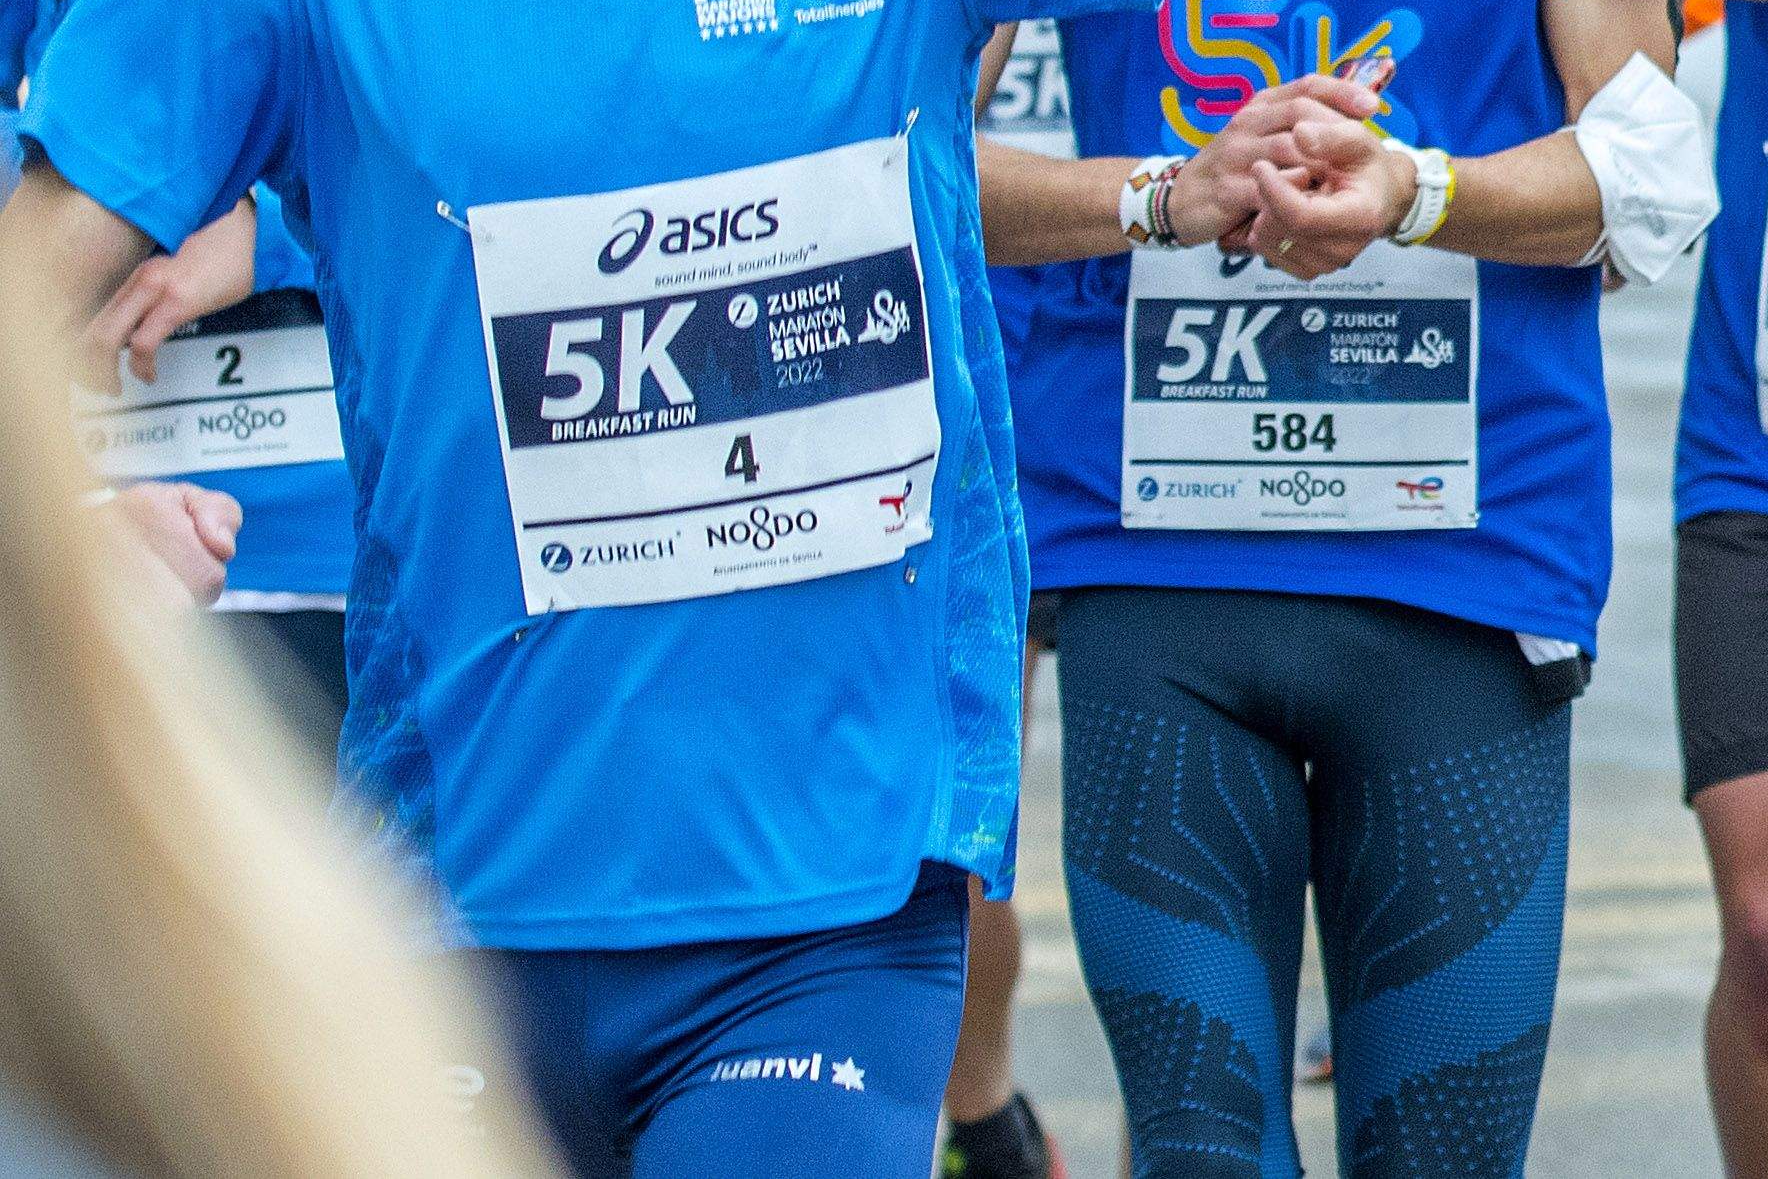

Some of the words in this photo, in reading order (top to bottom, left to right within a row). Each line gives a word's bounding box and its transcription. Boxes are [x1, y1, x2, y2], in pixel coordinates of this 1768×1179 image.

[659, 198, 779, 255] asics
[654, 267, 696, 288] sound
[699, 262, 734, 282] mind,
[737, 251, 777, 273] sound
[767, 281, 842, 316] ZURICH
[769, 305, 846, 341] MARATÓN
[1332, 312, 1399, 328] ZURICH
[540, 299, 698, 421] 5K
[771, 326, 851, 362] SEVILLA
[1156, 306, 1282, 383] 5K
[1329, 348, 1399, 364] SEVILLA
[214, 344, 244, 387] 2
[776, 357, 823, 389] 2022
[1160, 384, 1236, 399] BREAKFAST
[1237, 384, 1269, 399] RUN
[551, 411, 655, 442] BREAKFAST
[657, 404, 697, 429] RUN
[1252, 412, 1337, 454] 584
[724, 432, 761, 485] 4
[1163, 480, 1236, 499] ZURICH
[580, 538, 675, 567] ZURICH
